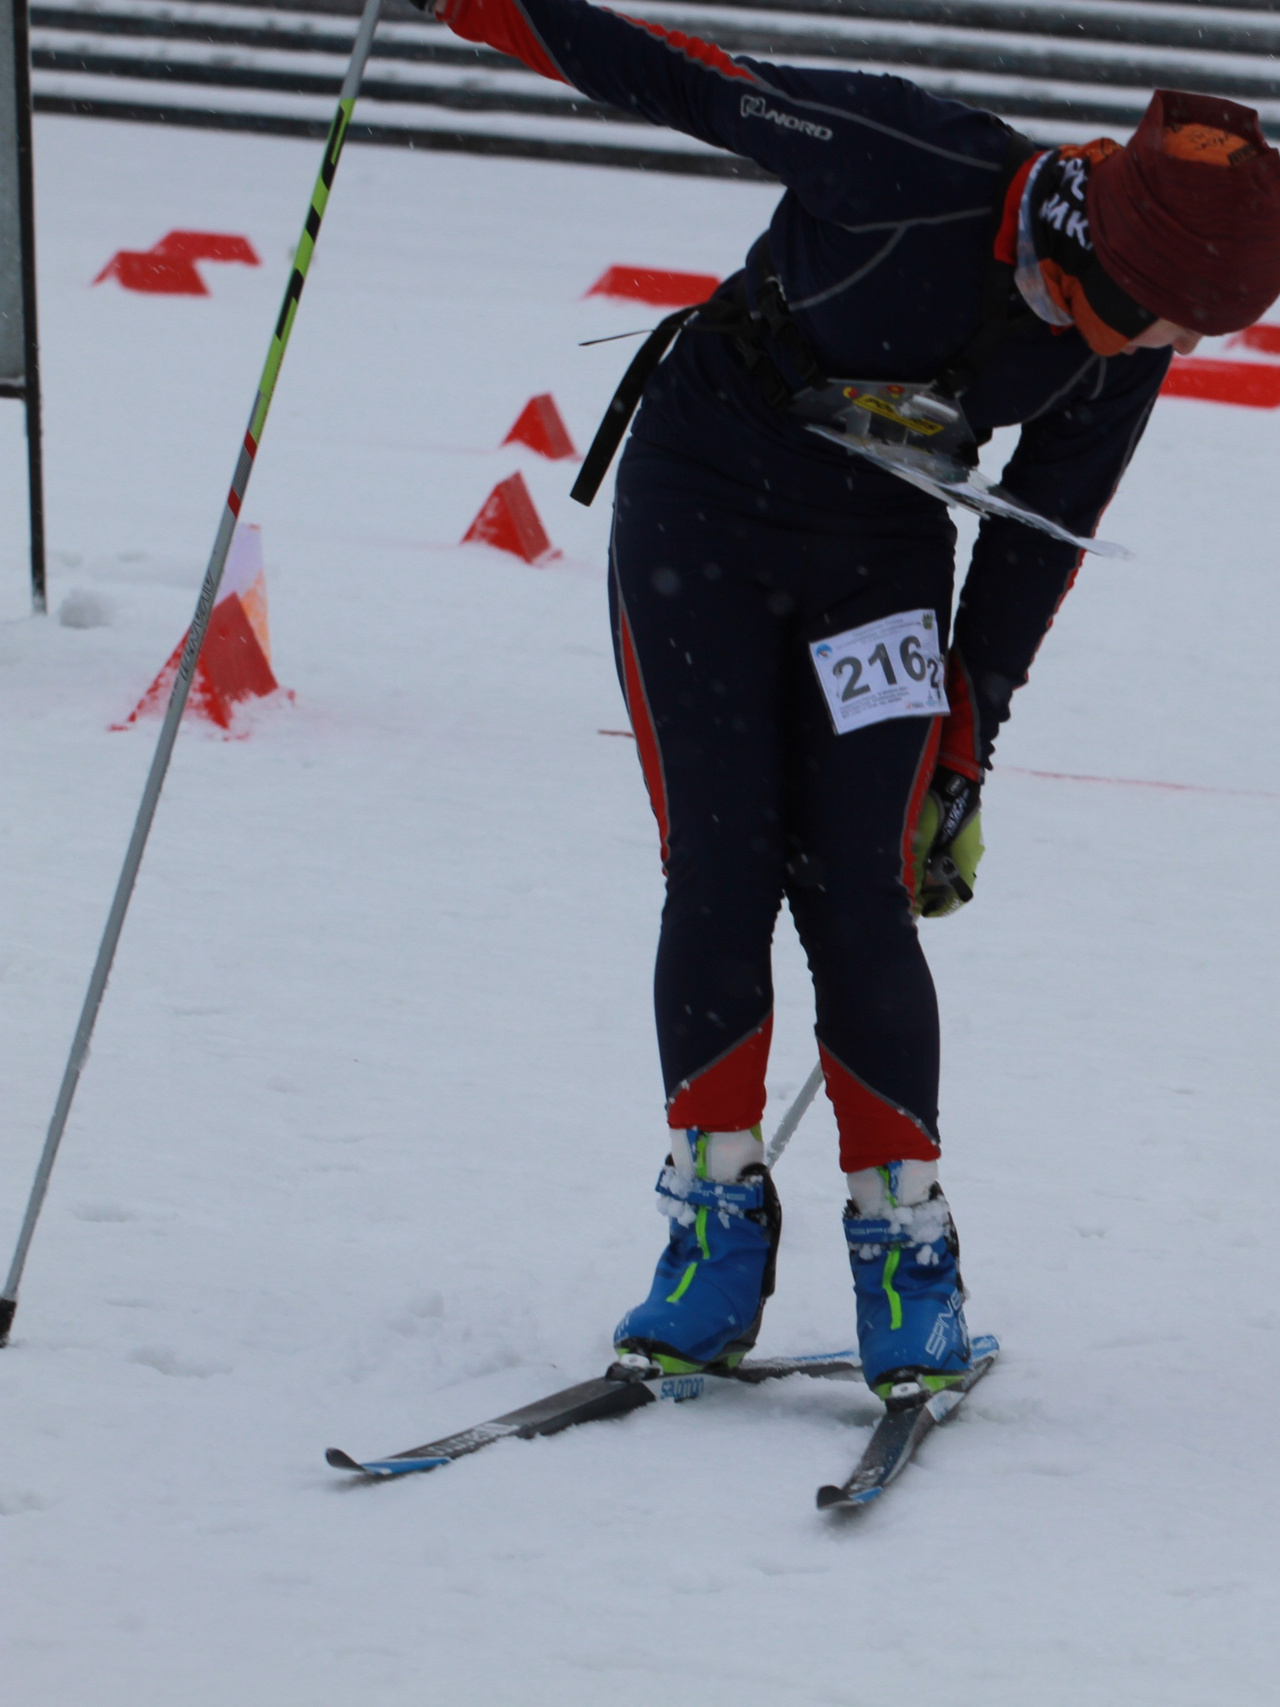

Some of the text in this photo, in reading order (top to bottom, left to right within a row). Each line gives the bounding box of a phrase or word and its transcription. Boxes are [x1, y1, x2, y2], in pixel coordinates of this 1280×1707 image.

[765, 110, 833, 141] NORD
[832, 635, 939, 702] 216 2
[925, 1287, 964, 1361] SPINE
